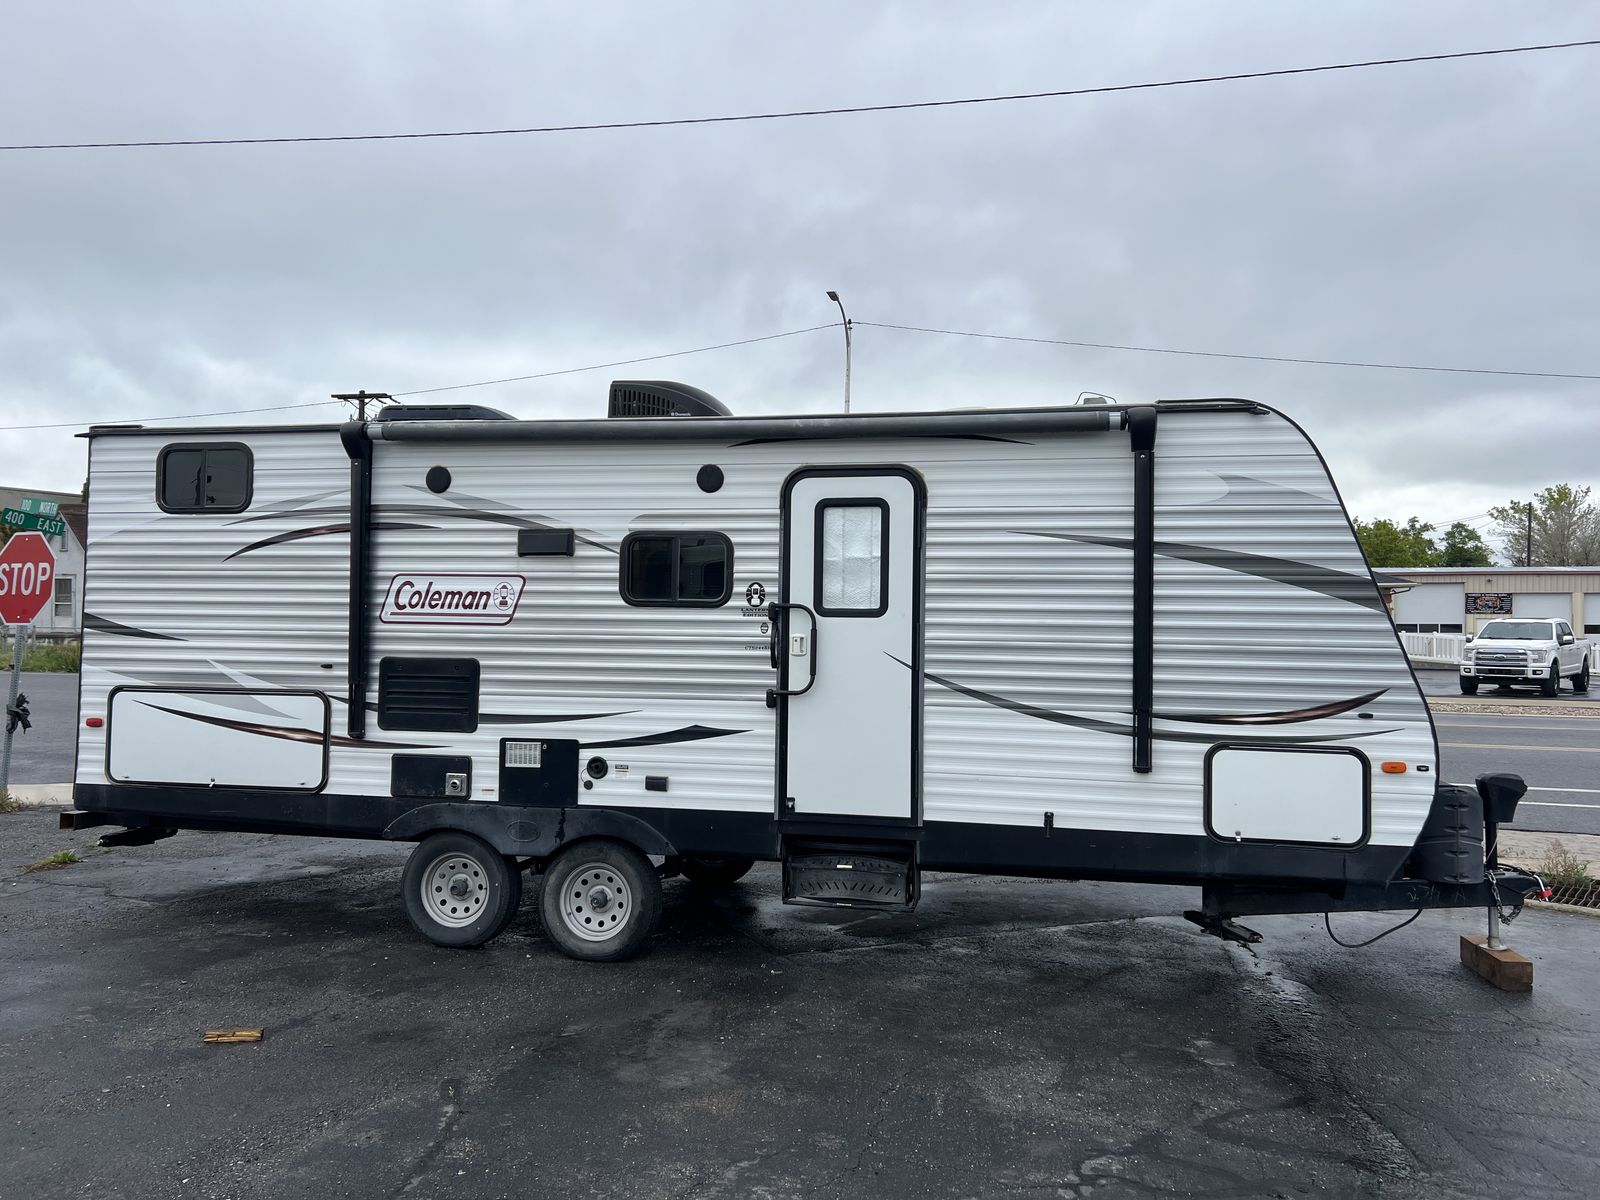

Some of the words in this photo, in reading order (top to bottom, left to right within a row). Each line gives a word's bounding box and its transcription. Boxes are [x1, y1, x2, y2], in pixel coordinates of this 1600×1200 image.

[39, 502, 58, 514] NORTH
[5, 511, 25, 525] 400
[37, 518, 62, 533] EAST
[0, 562, 51, 596] STOP
[394, 580, 492, 611] Coleman
